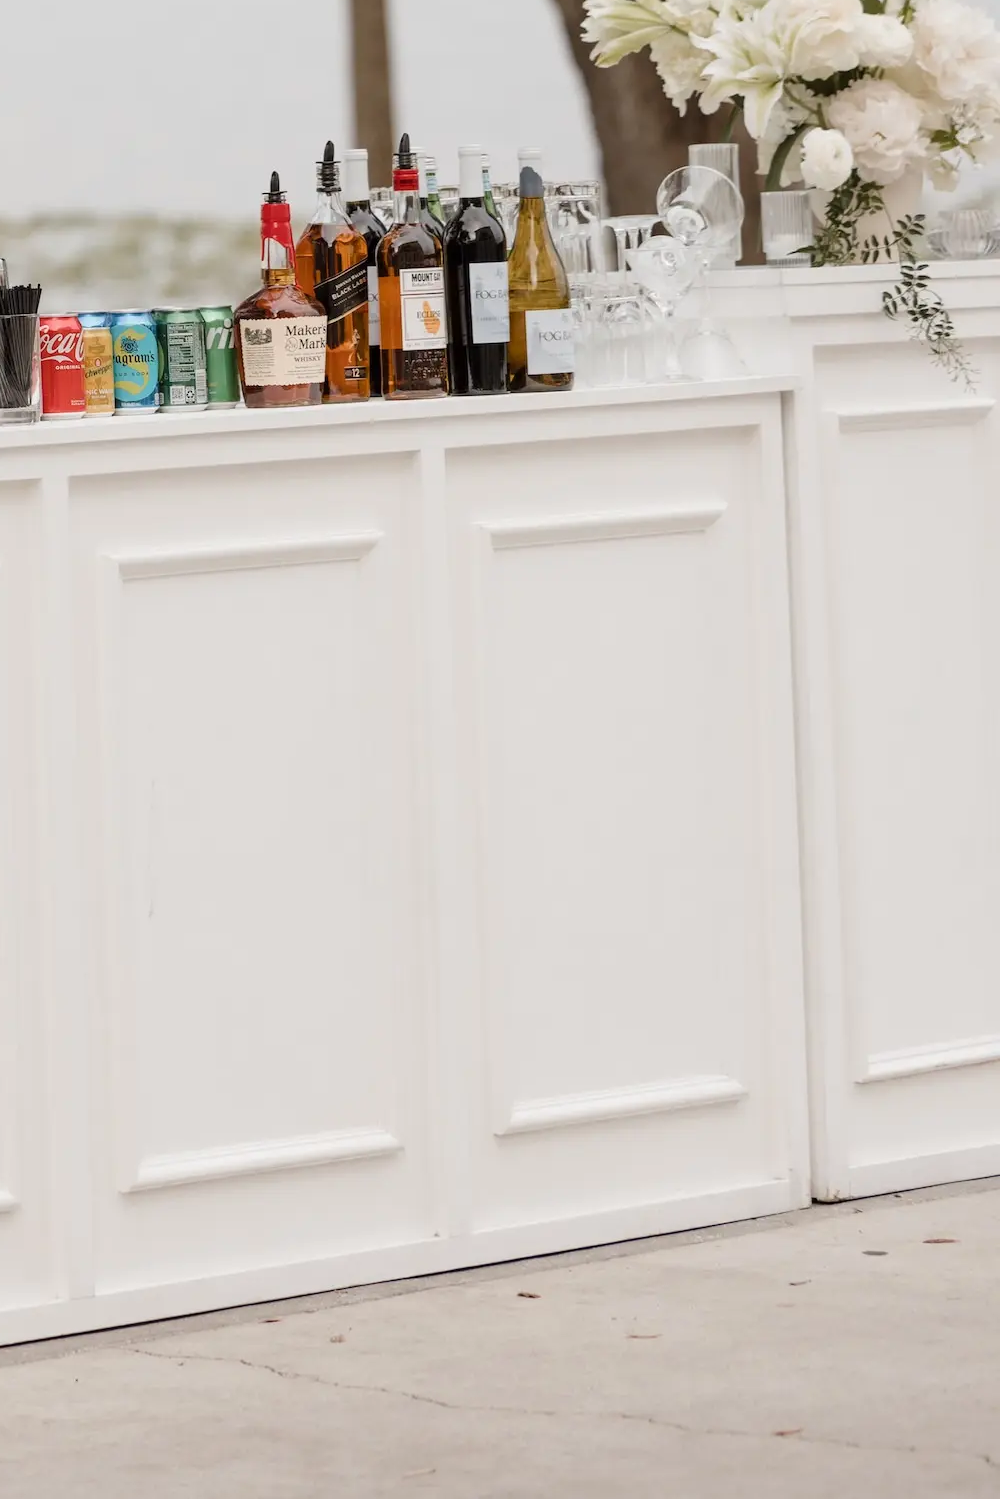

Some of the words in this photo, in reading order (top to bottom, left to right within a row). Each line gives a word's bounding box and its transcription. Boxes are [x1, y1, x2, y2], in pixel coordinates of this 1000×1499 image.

[411, 272, 433, 283] MOUNT
[331, 286, 352, 300] BLACK
[475, 289, 497, 300] FOG
[285, 324, 327, 337] Maker's
[538, 331, 562, 342] FOG
[298, 337, 326, 350] Mark
[112, 351, 155, 366] agram's
[351, 368, 360, 378] 12
